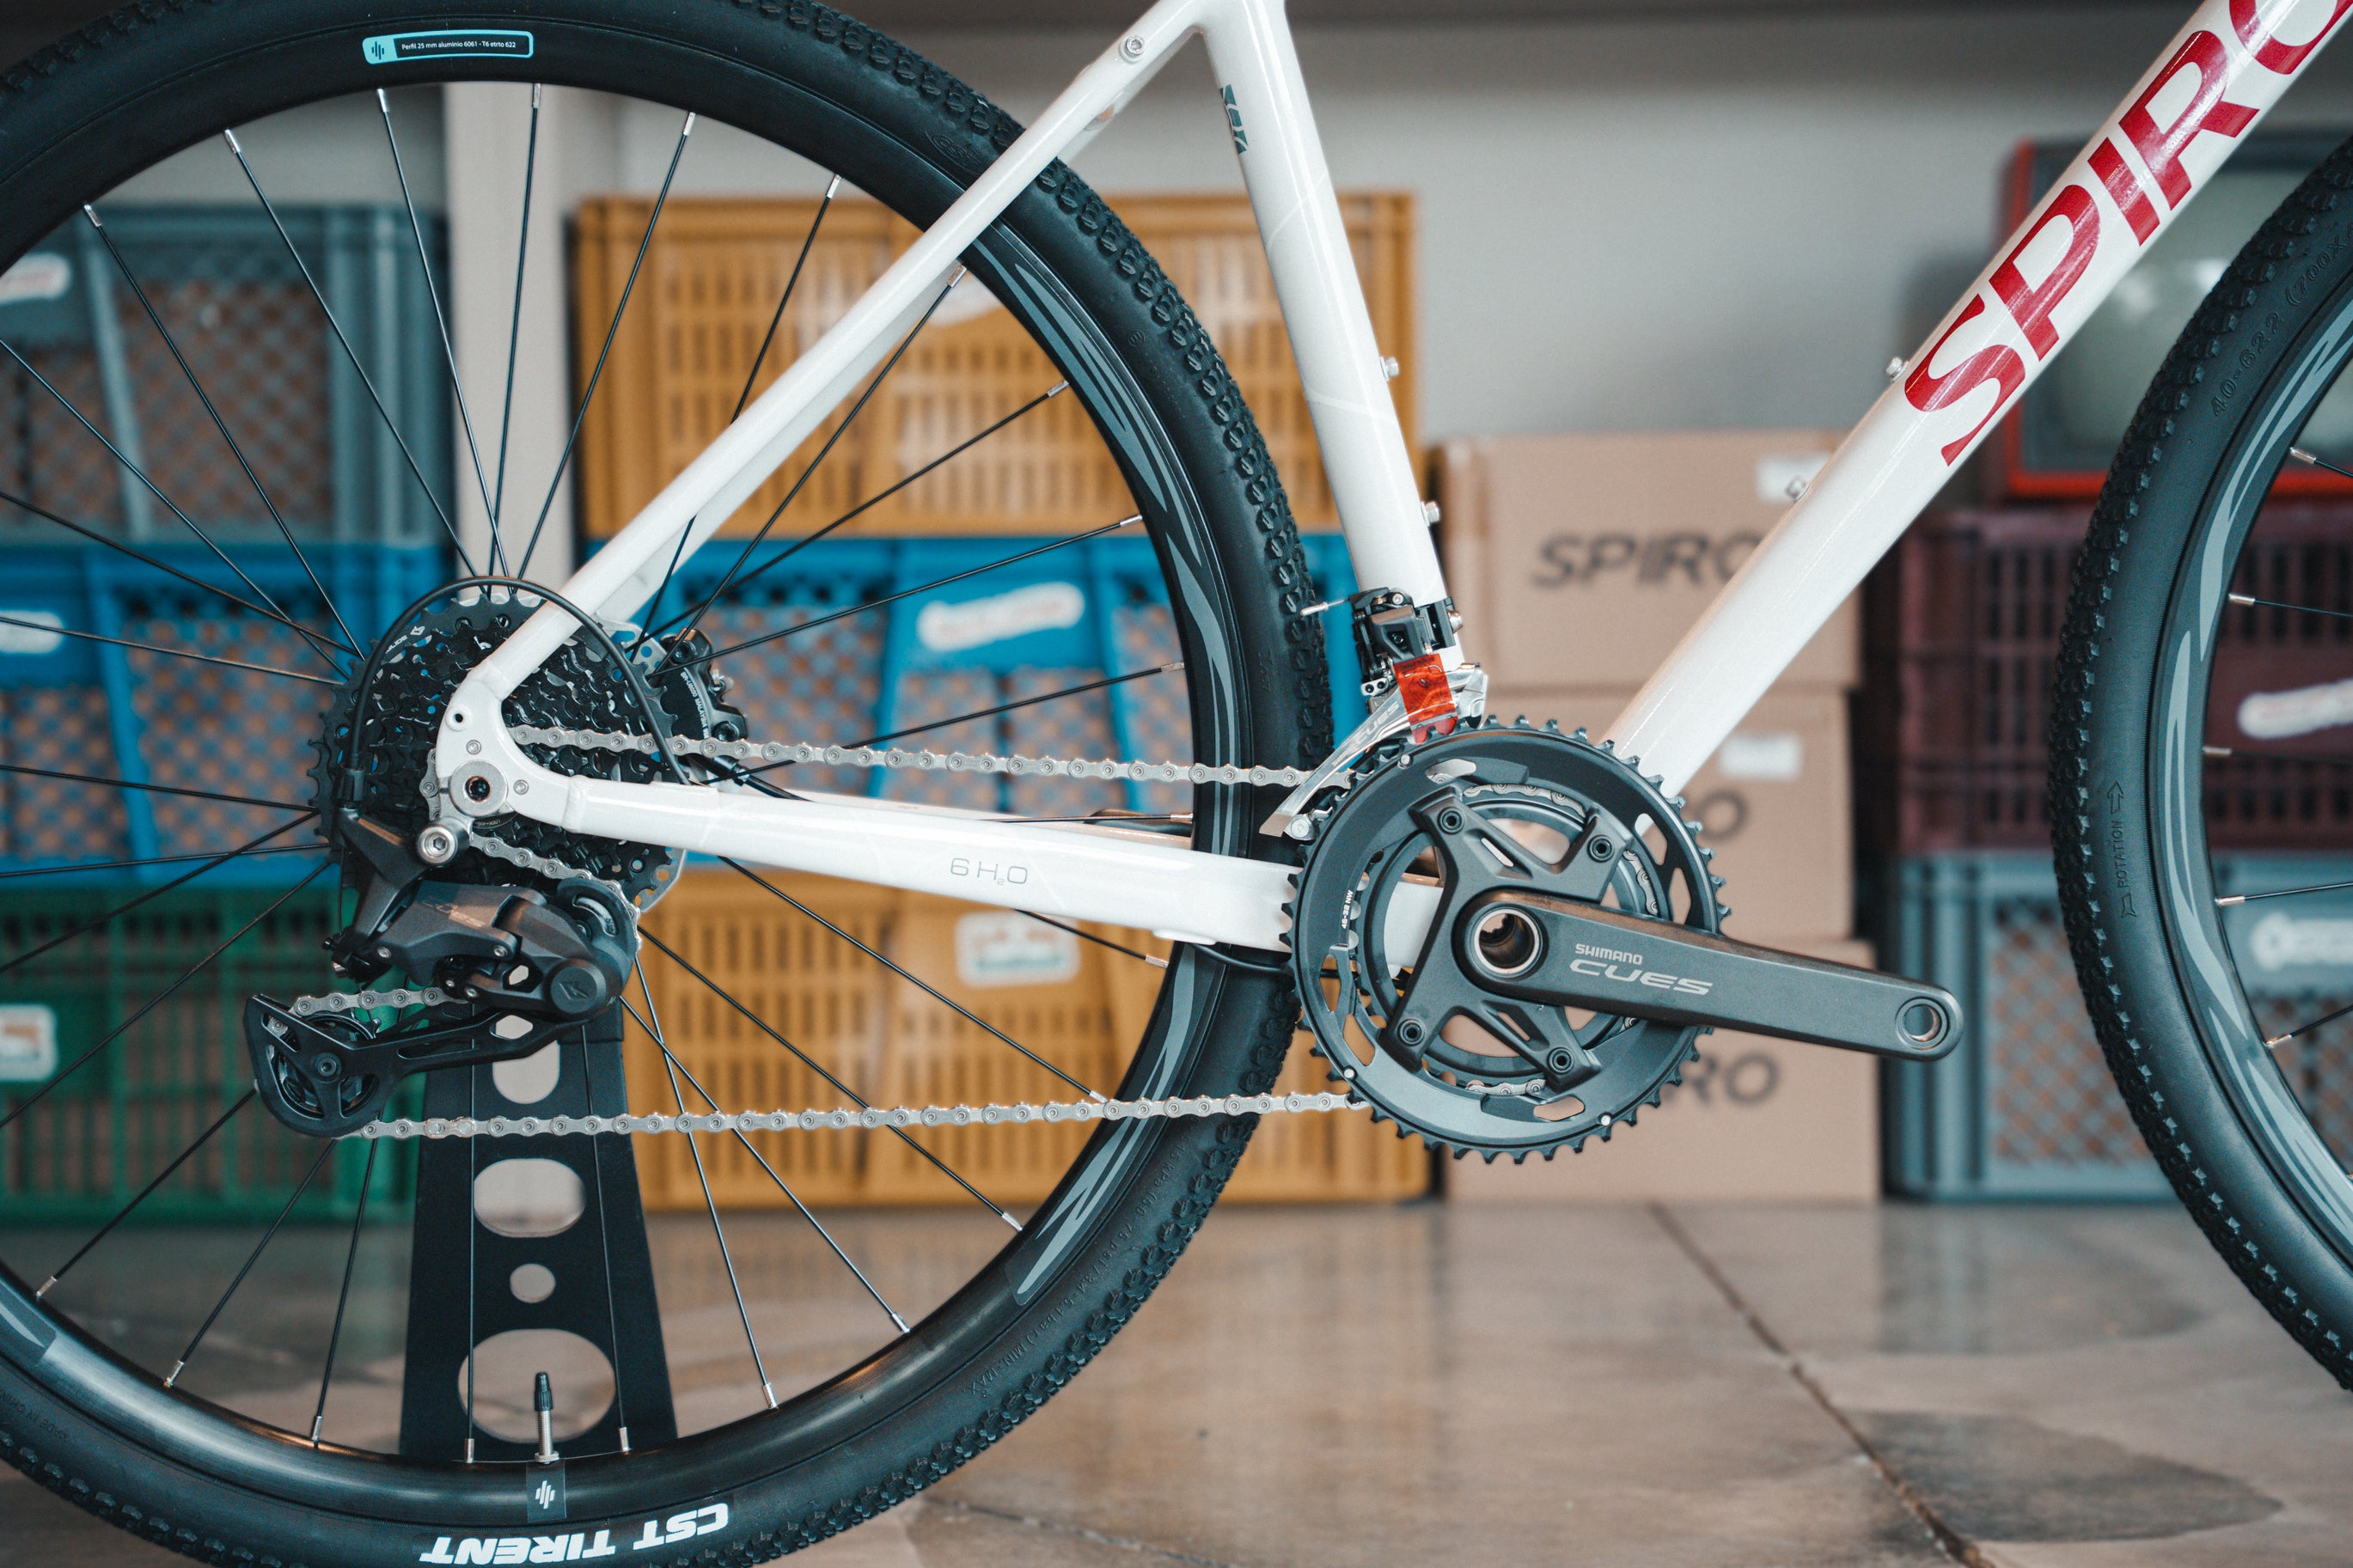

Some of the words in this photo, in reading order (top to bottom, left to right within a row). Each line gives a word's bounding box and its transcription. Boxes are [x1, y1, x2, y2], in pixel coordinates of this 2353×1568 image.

[694, 698, 708, 728] MALAYSIA
[1574, 943, 1643, 966] SHIMANO
[1569, 958, 1714, 996] CUES
[633, 1502, 729, 1551] CST
[419, 1528, 616, 1565] TIRENT
